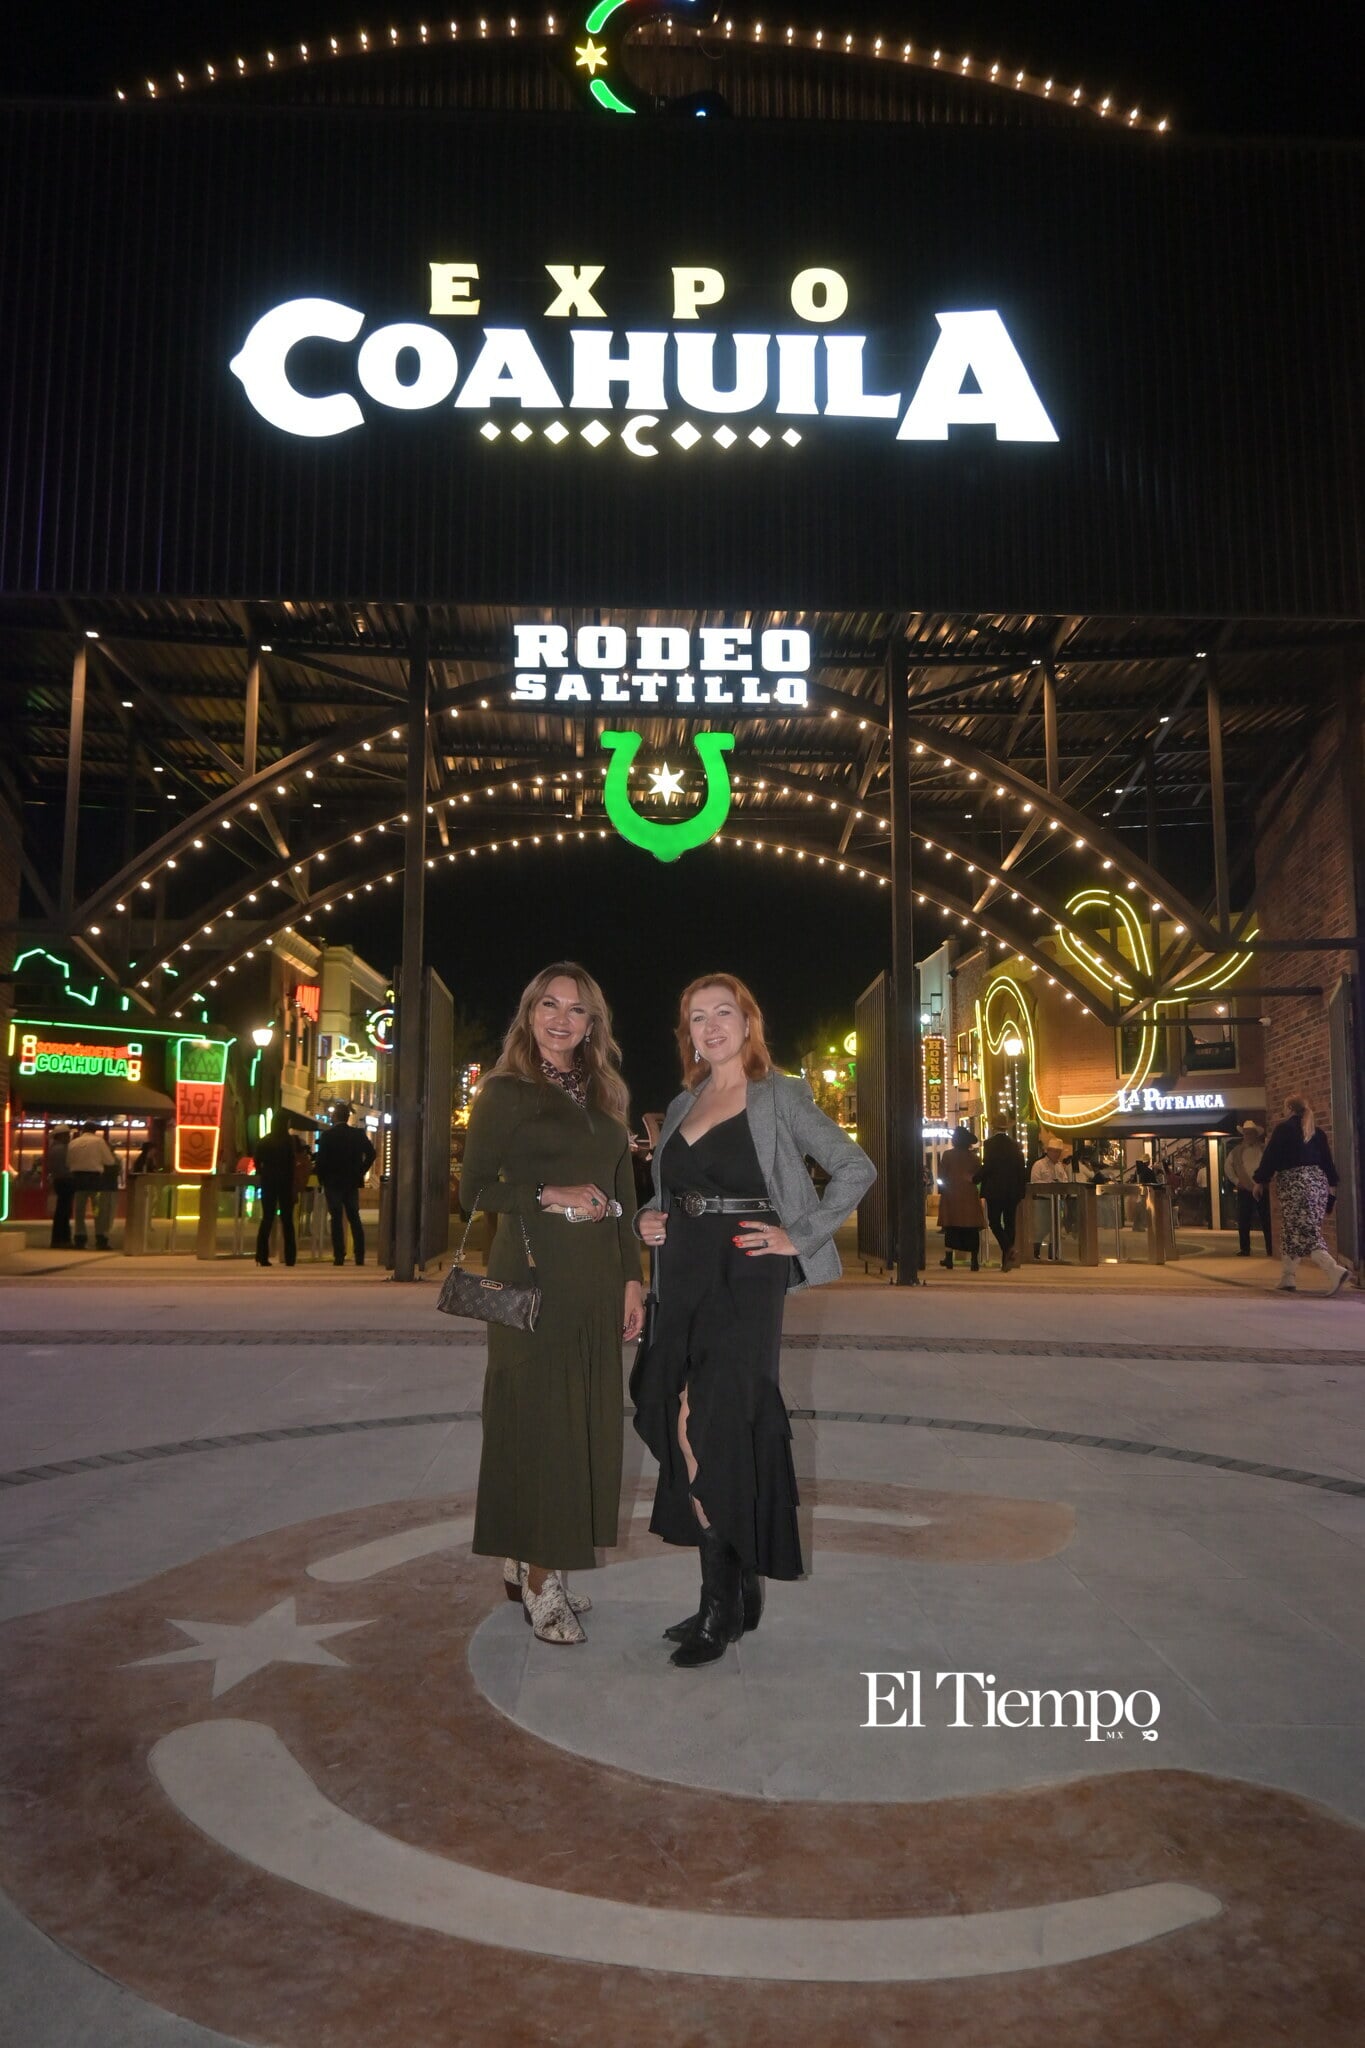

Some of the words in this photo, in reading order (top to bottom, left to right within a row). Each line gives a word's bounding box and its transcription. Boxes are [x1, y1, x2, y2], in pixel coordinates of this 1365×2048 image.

[428, 261, 849, 323] EXPO
[229, 297, 1060, 443] COAHUILA
[513, 624, 811, 672] RODEO
[513, 673, 809, 705] SALTILLO
[928, 1040, 941, 1079] HONKY
[929, 1085, 941, 1117] TONK
[1117, 1089, 1140, 1112] LA
[1142, 1087, 1225, 1111] POTRANCA
